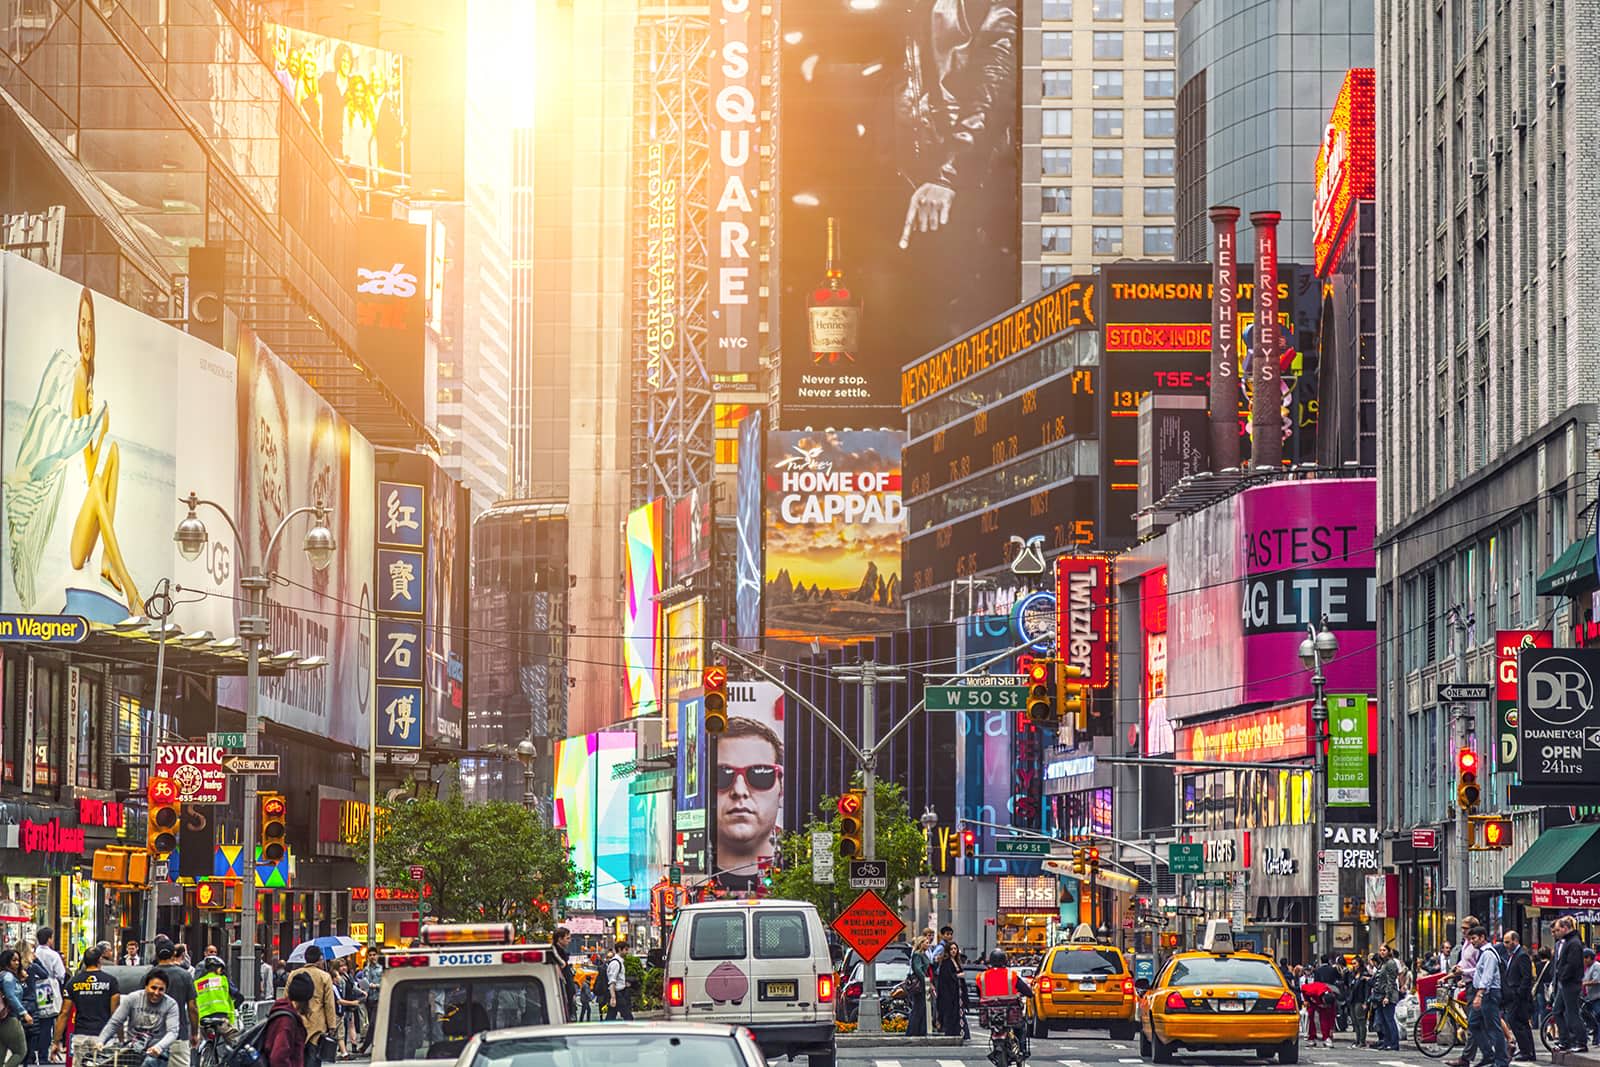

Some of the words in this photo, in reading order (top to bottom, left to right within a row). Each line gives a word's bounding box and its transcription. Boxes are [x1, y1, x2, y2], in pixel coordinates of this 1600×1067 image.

[716, 41, 756, 304] SQUARE
[648, 143, 663, 229] EAGLE
[661, 178, 676, 350] OUTFITTERS
[1112, 284, 1202, 299] THOMSON
[647, 237, 662, 389] AMERICAN
[719, 337, 748, 349] NYC
[1110, 327, 1165, 346] STOCK
[929, 306, 1032, 395] BACK-TO-THE-FUTURE
[802, 375, 835, 385] Never
[838, 375, 867, 386] stop.
[799, 388, 832, 398] Never
[834, 387, 870, 398] settle.
[775, 454, 833, 475] Turkey
[782, 471, 853, 492] HOME
[857, 471, 890, 492] OF
[781, 494, 907, 524] CAPPAD
[1244, 526, 1358, 568] FASTEST
[1242, 581, 1270, 628] 4G
[1276, 577, 1349, 626] LTE
[17, 618, 78, 640] Wagner
[727, 686, 756, 702] HILL
[1447, 689, 1463, 697] ONE
[1466, 689, 1483, 697] WAY
[1527, 671, 1594, 711] DR
[947, 691, 961, 705] W
[968, 690, 992, 706] 50
[998, 690, 1018, 706] St
[217, 735, 224, 746] W
[227, 735, 237, 746] 50
[1205, 735, 1220, 756] new
[1221, 723, 1237, 761] york
[1237, 720, 1262, 759] sports
[1263, 716, 1285, 748] clubs
[1333, 737, 1364, 745] TASTE
[157, 746, 224, 765] PSYCHIC
[1541, 746, 1582, 759] OPEN
[231, 760, 249, 769] ONE
[253, 760, 272, 769] WAY
[1541, 760, 1583, 774] 24hrs
[1333, 773, 1356, 782] June
[1357, 773, 1364, 781] 2
[1324, 827, 1380, 844] PARK
[1006, 844, 1013, 852] W
[1016, 844, 1029, 852] 49
[1031, 844, 1041, 852] St
[1343, 849, 1374, 859] OPEN
[1343, 858, 1356, 869] 24
[853, 879, 867, 887] BIKE
[869, 879, 885, 887] PATH
[1555, 887, 1569, 897] The
[1570, 888, 1589, 897] Anne
[1590, 888, 1599, 897] L.
[1565, 896, 1579, 905] The
[1579, 896, 1597, 907] Jerry
[876, 919, 893, 927] AHEAD
[850, 928, 873, 937] PROCEED
[874, 928, 886, 936] WITH
[857, 938, 879, 946] CAUTION
[438, 954, 493, 965] POLICE
[91, 982, 110, 992] TEAM
